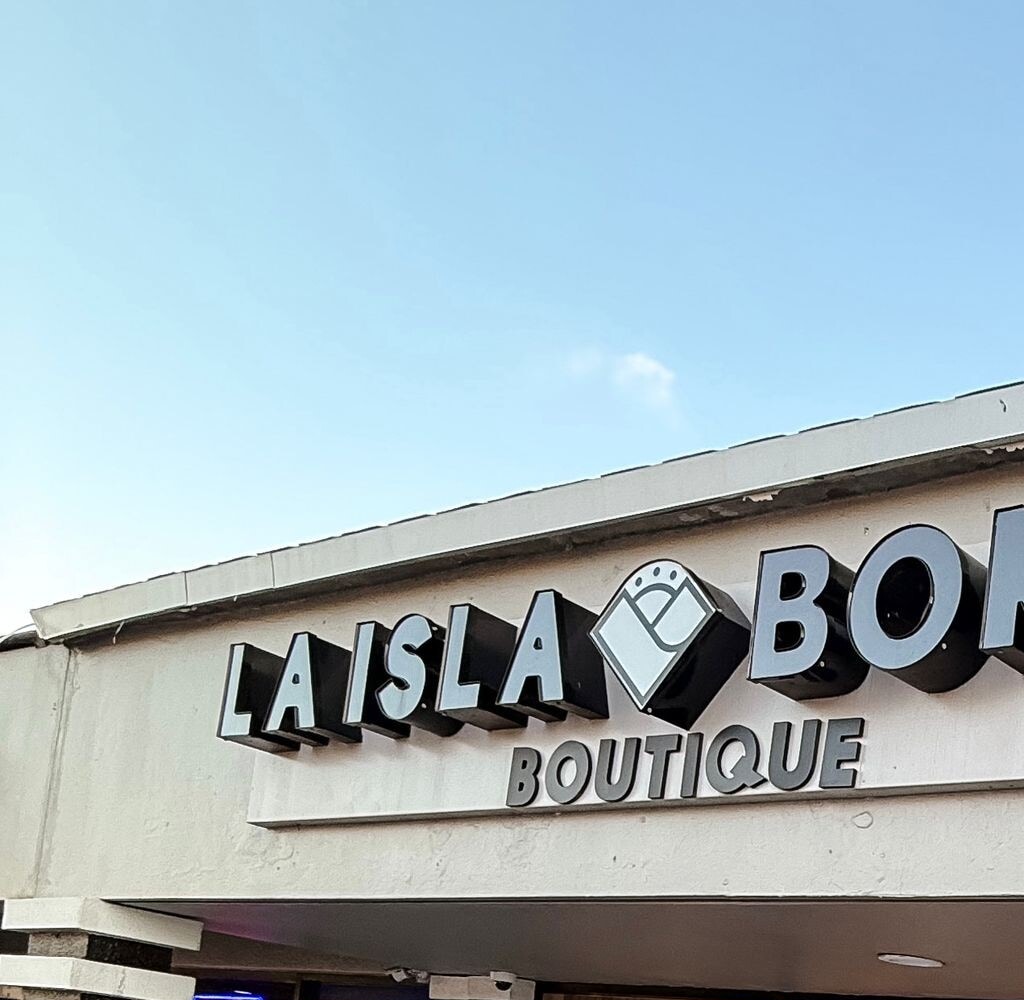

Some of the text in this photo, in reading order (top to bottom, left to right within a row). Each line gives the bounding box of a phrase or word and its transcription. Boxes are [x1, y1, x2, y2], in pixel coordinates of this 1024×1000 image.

[217, 629, 342, 748] LA
[344, 589, 596, 733] ISLA
[506, 717, 864, 808] BOUTIQUE
